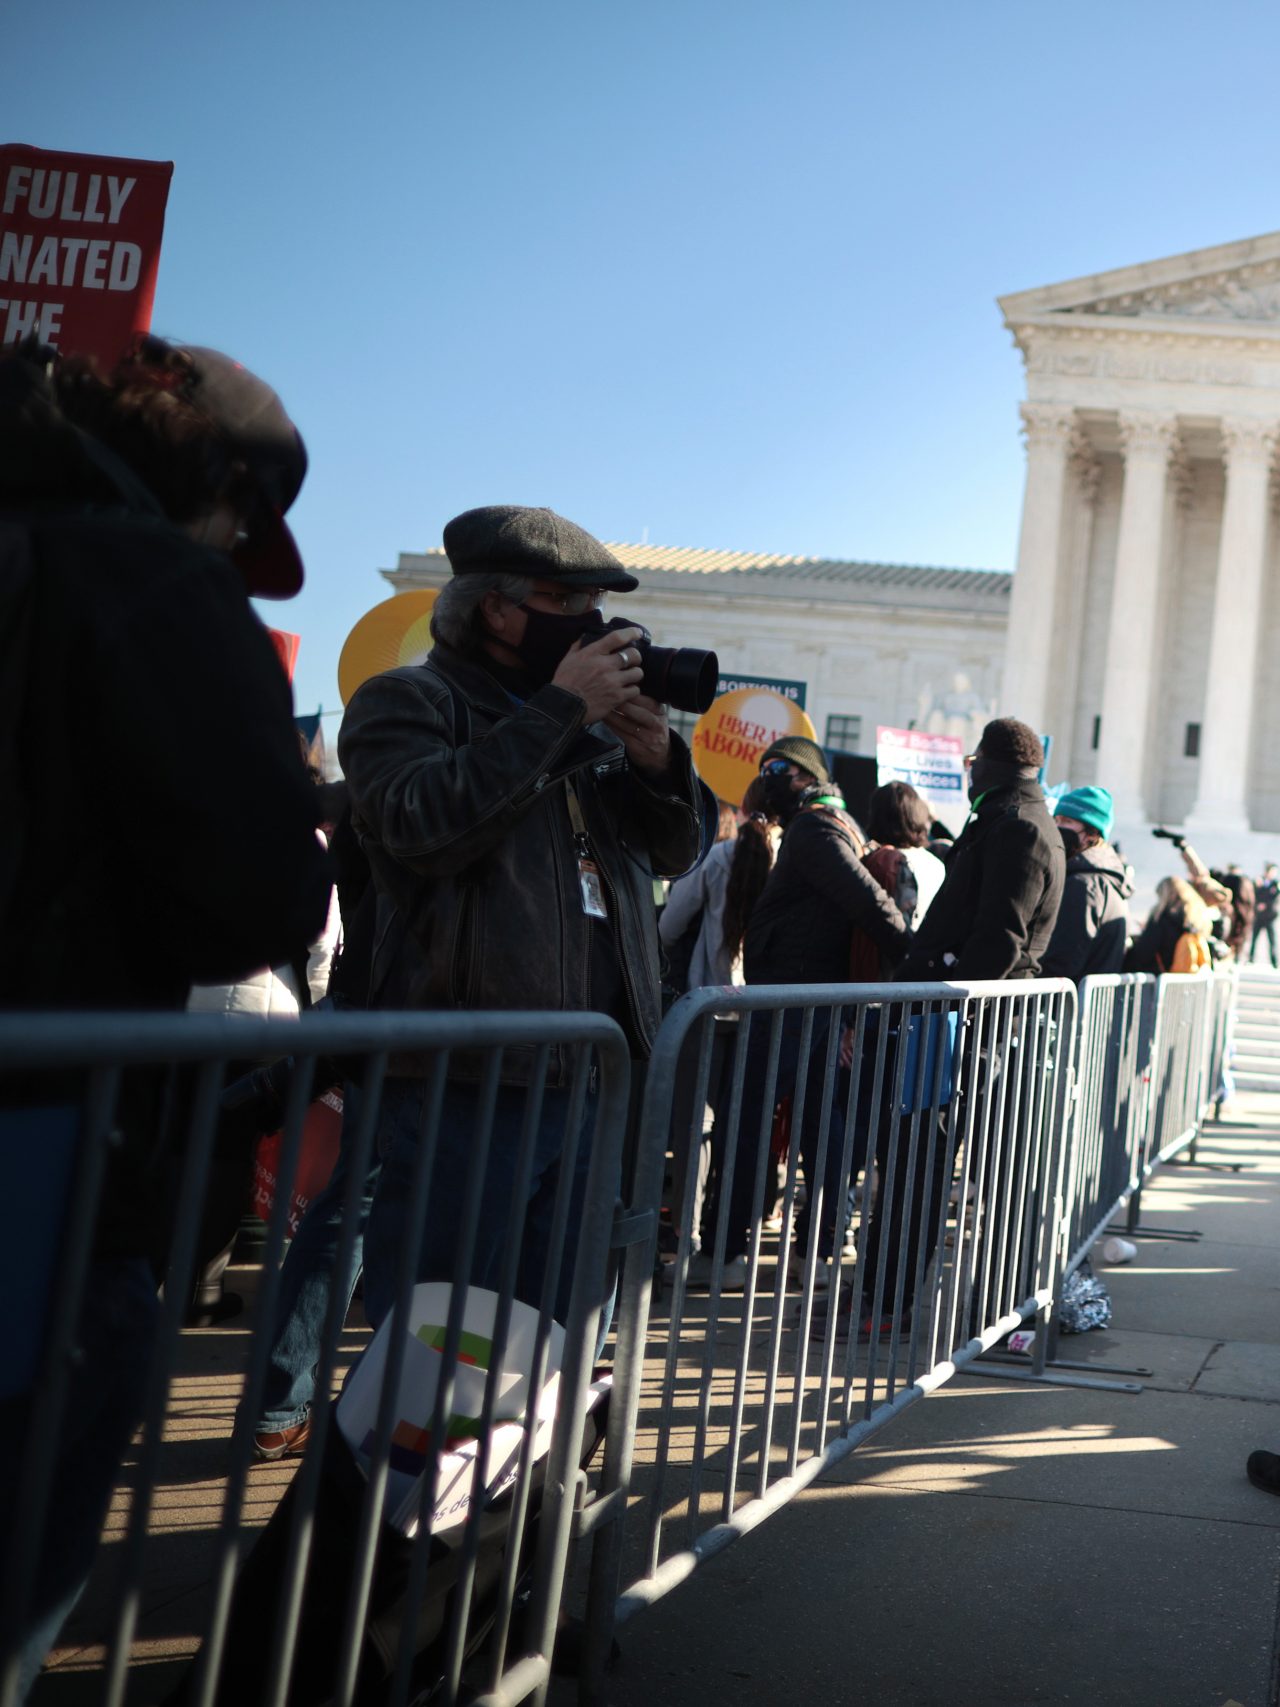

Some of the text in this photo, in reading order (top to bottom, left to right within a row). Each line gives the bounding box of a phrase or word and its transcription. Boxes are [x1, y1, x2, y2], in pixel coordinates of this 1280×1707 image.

[2, 165, 137, 224] FULLY
[0, 231, 142, 291] NATED
[0, 298, 64, 350] HE
[698, 728, 766, 764] ABOR
[718, 713, 788, 743] LIBERA
